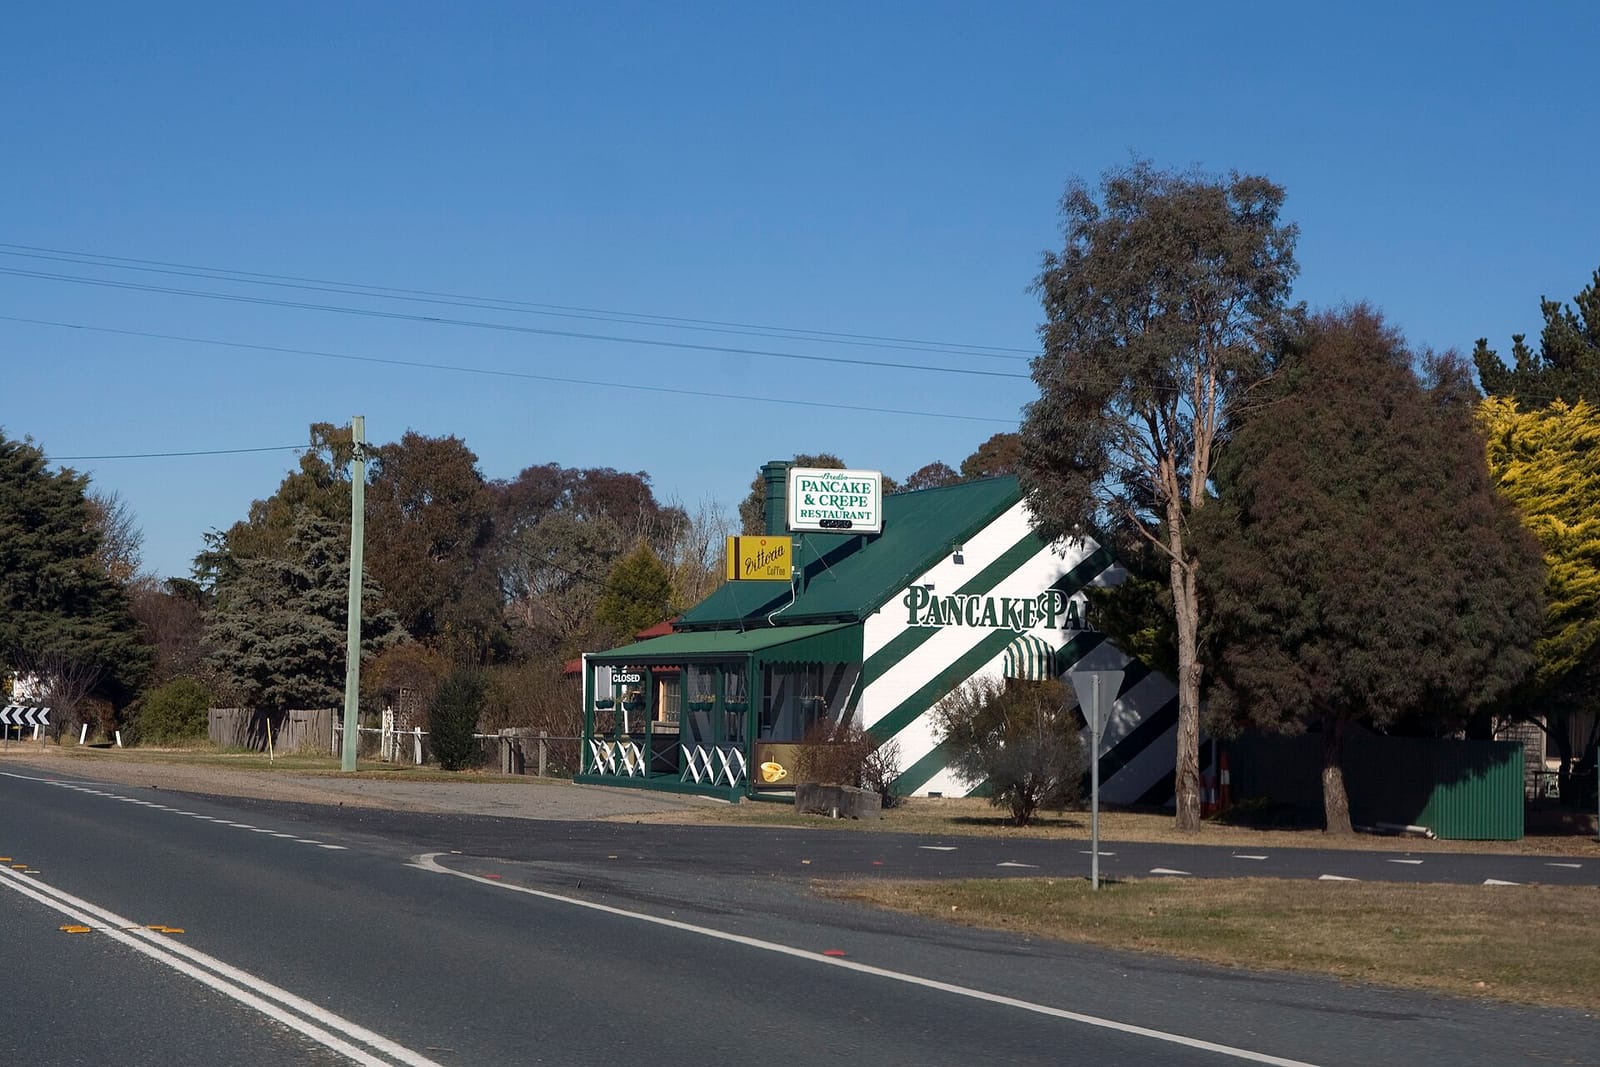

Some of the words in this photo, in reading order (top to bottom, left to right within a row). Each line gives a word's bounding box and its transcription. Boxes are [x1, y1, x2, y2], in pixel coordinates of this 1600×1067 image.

[801, 480, 871, 494] PANCAKE
[804, 494, 815, 505] &
[819, 494, 868, 510] CREPE
[800, 509, 872, 520] RESTAURANT
[903, 585, 1038, 631] PANCAKE
[612, 673, 640, 683] CLOSED
